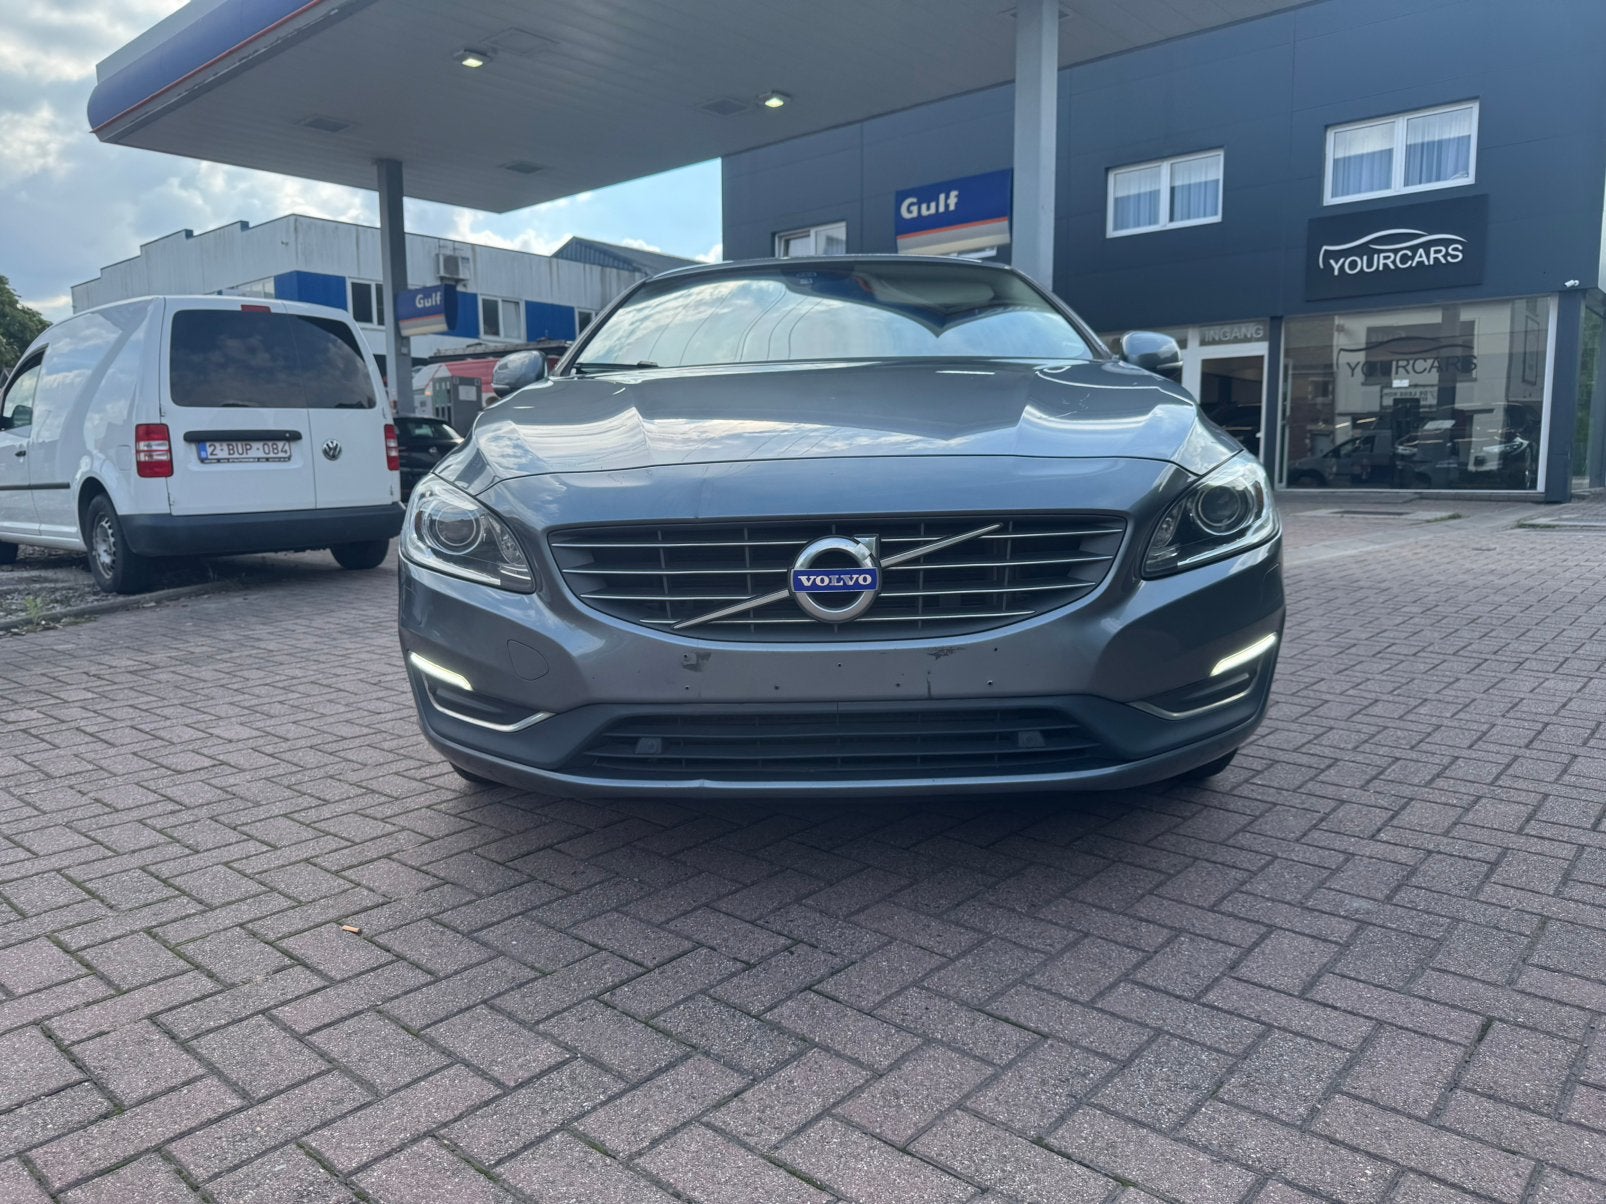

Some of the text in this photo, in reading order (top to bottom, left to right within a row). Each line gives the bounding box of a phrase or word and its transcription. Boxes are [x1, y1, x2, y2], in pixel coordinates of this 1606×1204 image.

[900, 190, 959, 219] Gulf
[1329, 244, 1463, 276] YOURCARS
[415, 292, 442, 308] Gulf
[1204, 325, 1264, 342] INGANG
[797, 574, 872, 586] VOLVO
